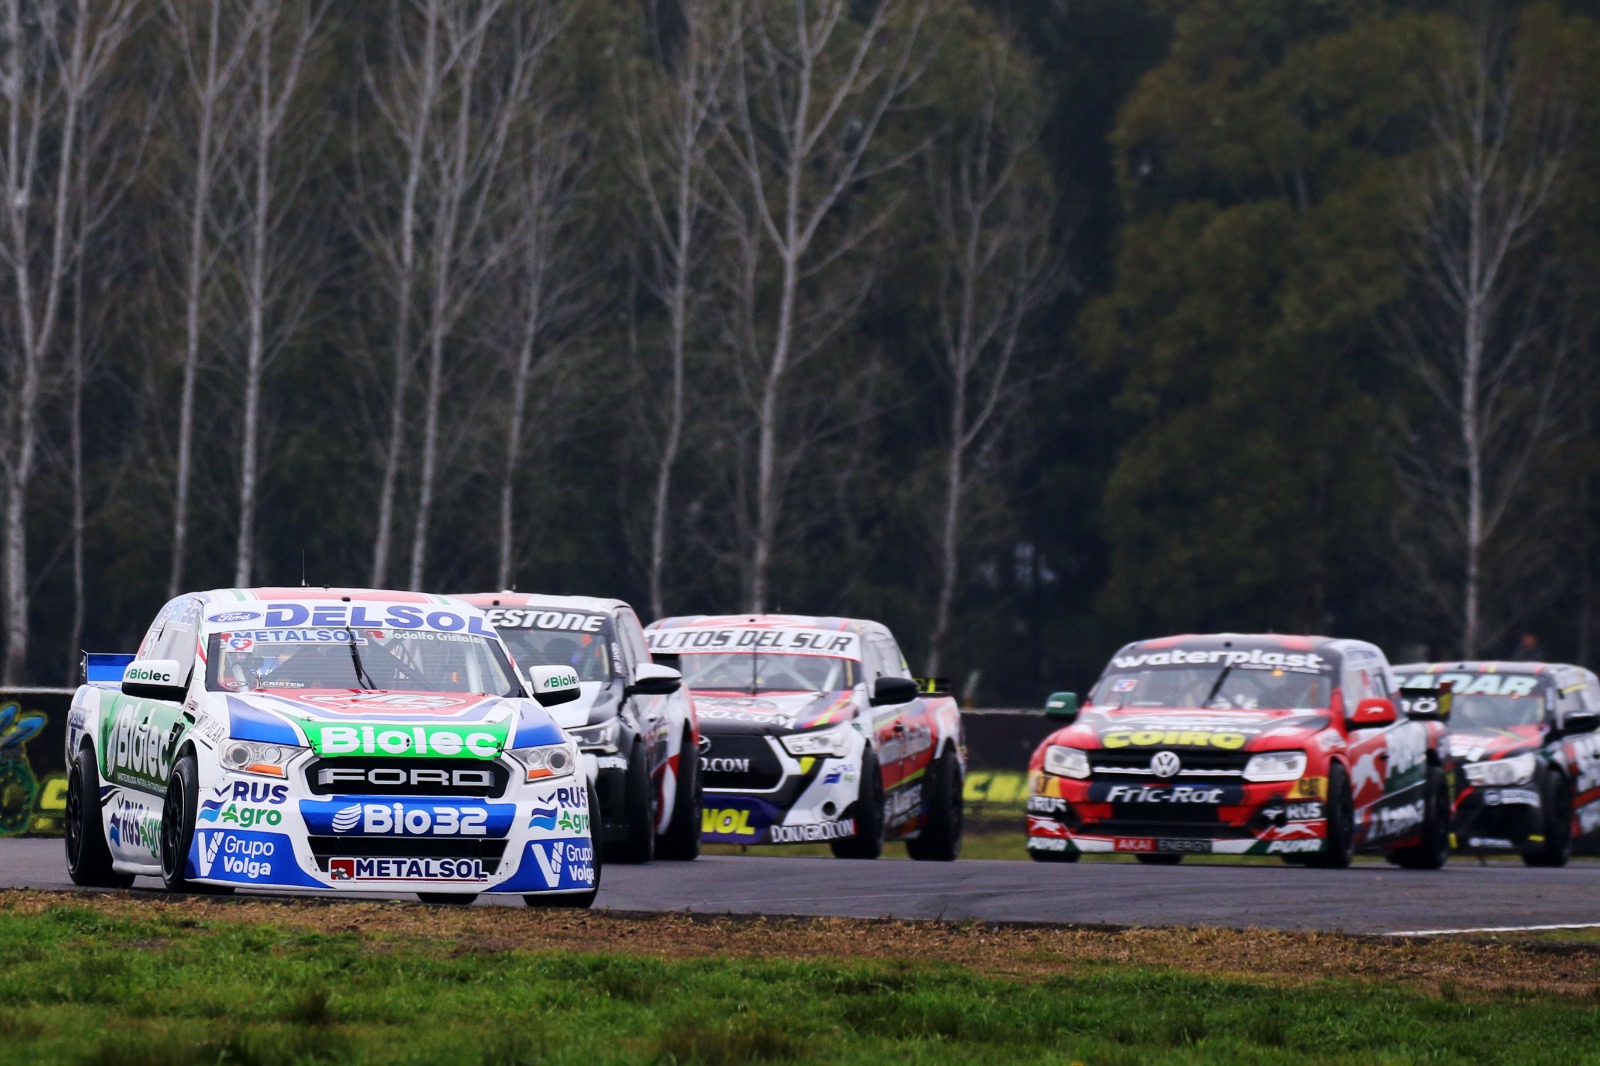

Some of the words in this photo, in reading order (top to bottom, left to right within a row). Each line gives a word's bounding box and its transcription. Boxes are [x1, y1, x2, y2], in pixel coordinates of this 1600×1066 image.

[264, 603, 499, 639] DELSOL
[234, 630, 361, 642] METALSOL
[736, 630, 782, 647] DEL
[790, 633, 853, 651] SUR
[1112, 649, 1324, 670] waterplast
[129, 668, 171, 682] Biolec
[550, 674, 579, 688] Biole
[117, 702, 173, 781] Biolec
[320, 725, 499, 757] Biolec
[318, 768, 495, 787] FORD
[232, 781, 289, 804] RUS
[1106, 785, 1224, 803] Fric-Rot
[221, 804, 282, 828] Agro
[363, 802, 489, 835] Bio32
[225, 835, 274, 859] Grupo
[223, 856, 272, 878] Volga
[356, 859, 488, 878] METALSOL
